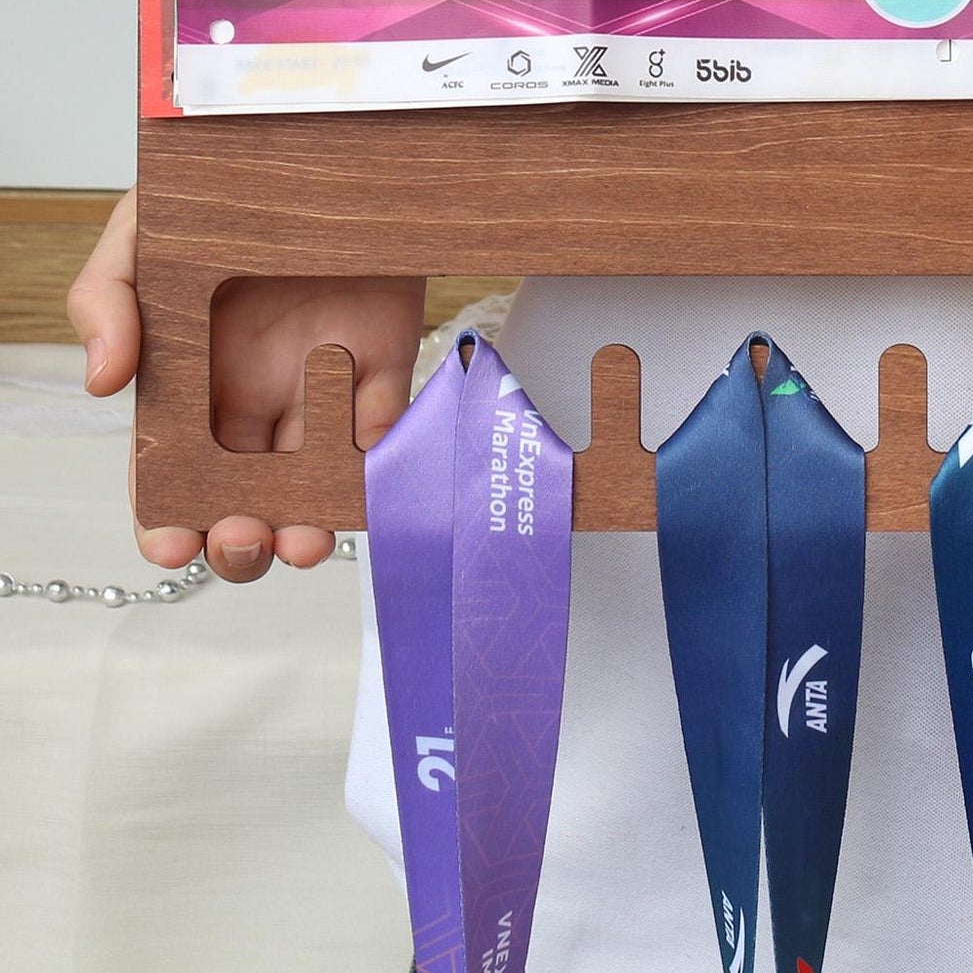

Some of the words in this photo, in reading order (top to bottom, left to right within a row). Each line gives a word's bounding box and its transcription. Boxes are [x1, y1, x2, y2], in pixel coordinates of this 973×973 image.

[562, 79, 589, 88] XMAX
[591, 78, 620, 88] MEDIA
[639, 79, 658, 89] Eight
[659, 79, 675, 89] Plus
[696, 58, 752, 84] 5bib
[490, 81, 549, 91] COROS
[489, 409, 516, 533] Marathon
[513, 409, 543, 536] VnExpress
[805, 679, 828, 734] ANTA
